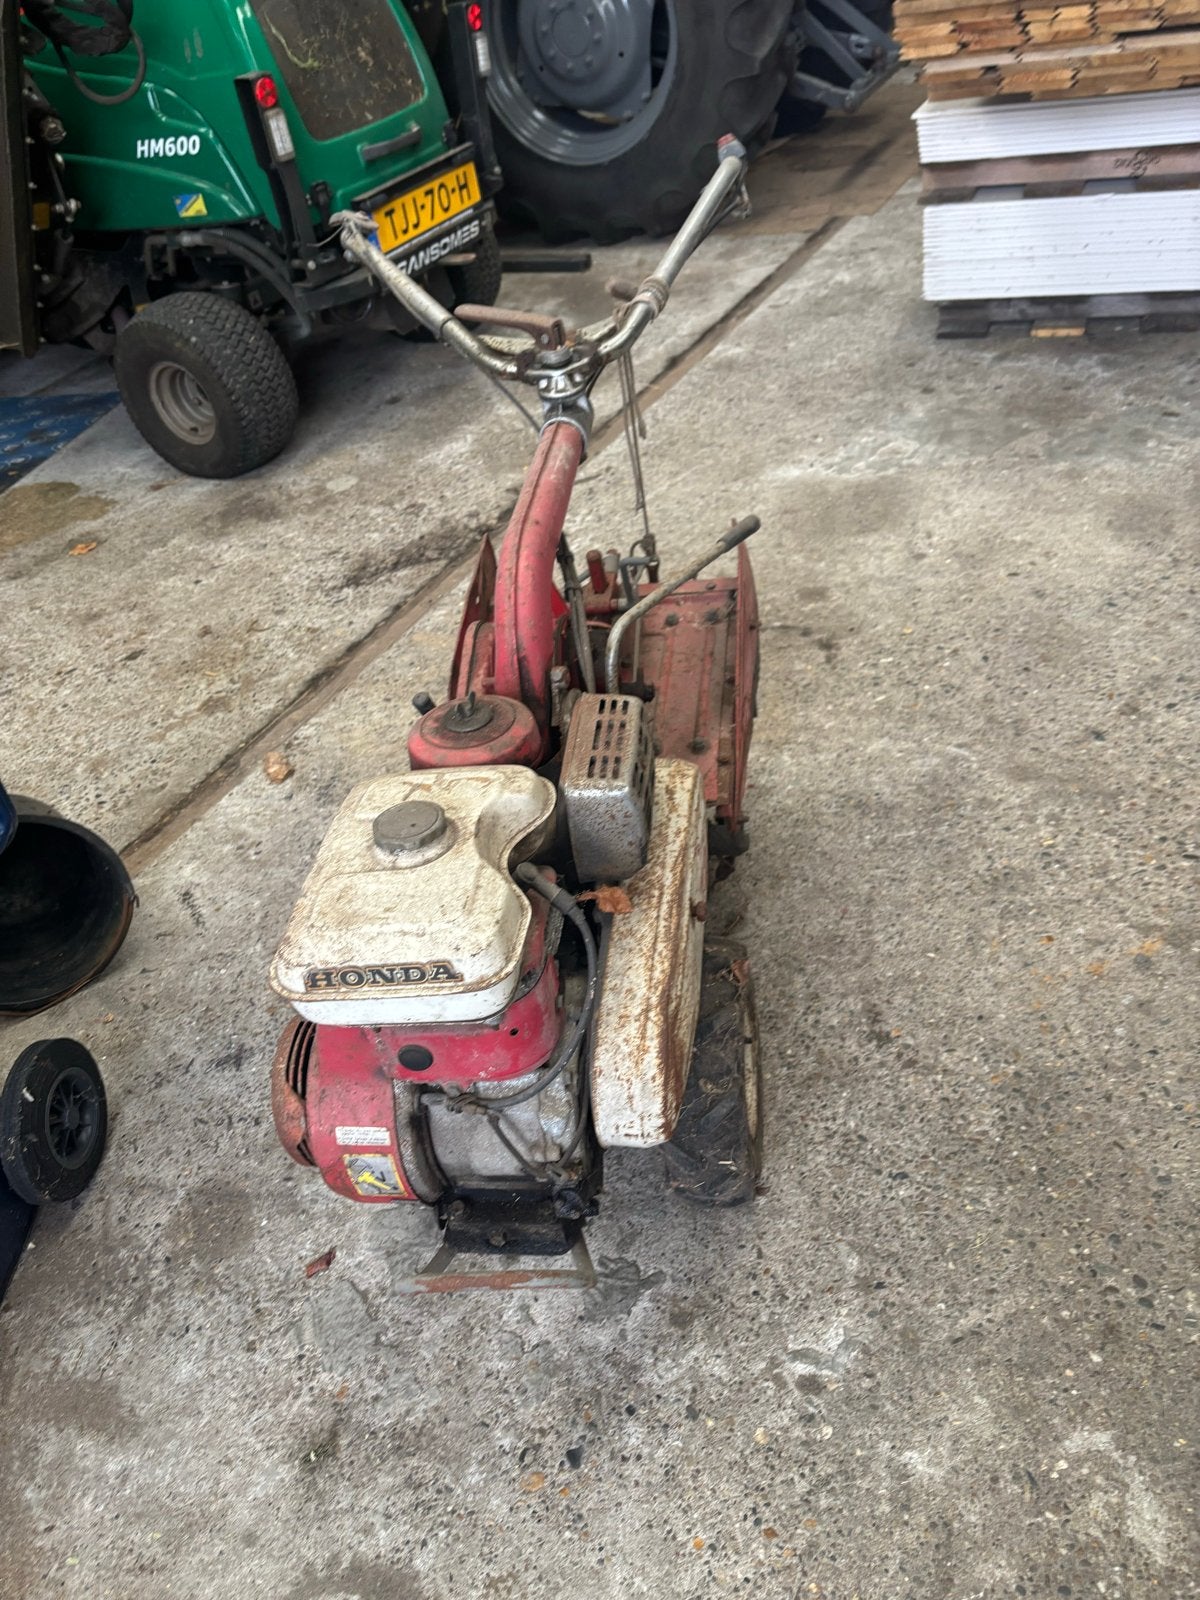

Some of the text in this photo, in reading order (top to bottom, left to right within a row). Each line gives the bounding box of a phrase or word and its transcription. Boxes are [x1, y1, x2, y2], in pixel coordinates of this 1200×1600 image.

[136, 134, 201, 159] HM600
[384, 171, 472, 241] TJJ-70-H
[305, 961, 464, 990] HONDA
